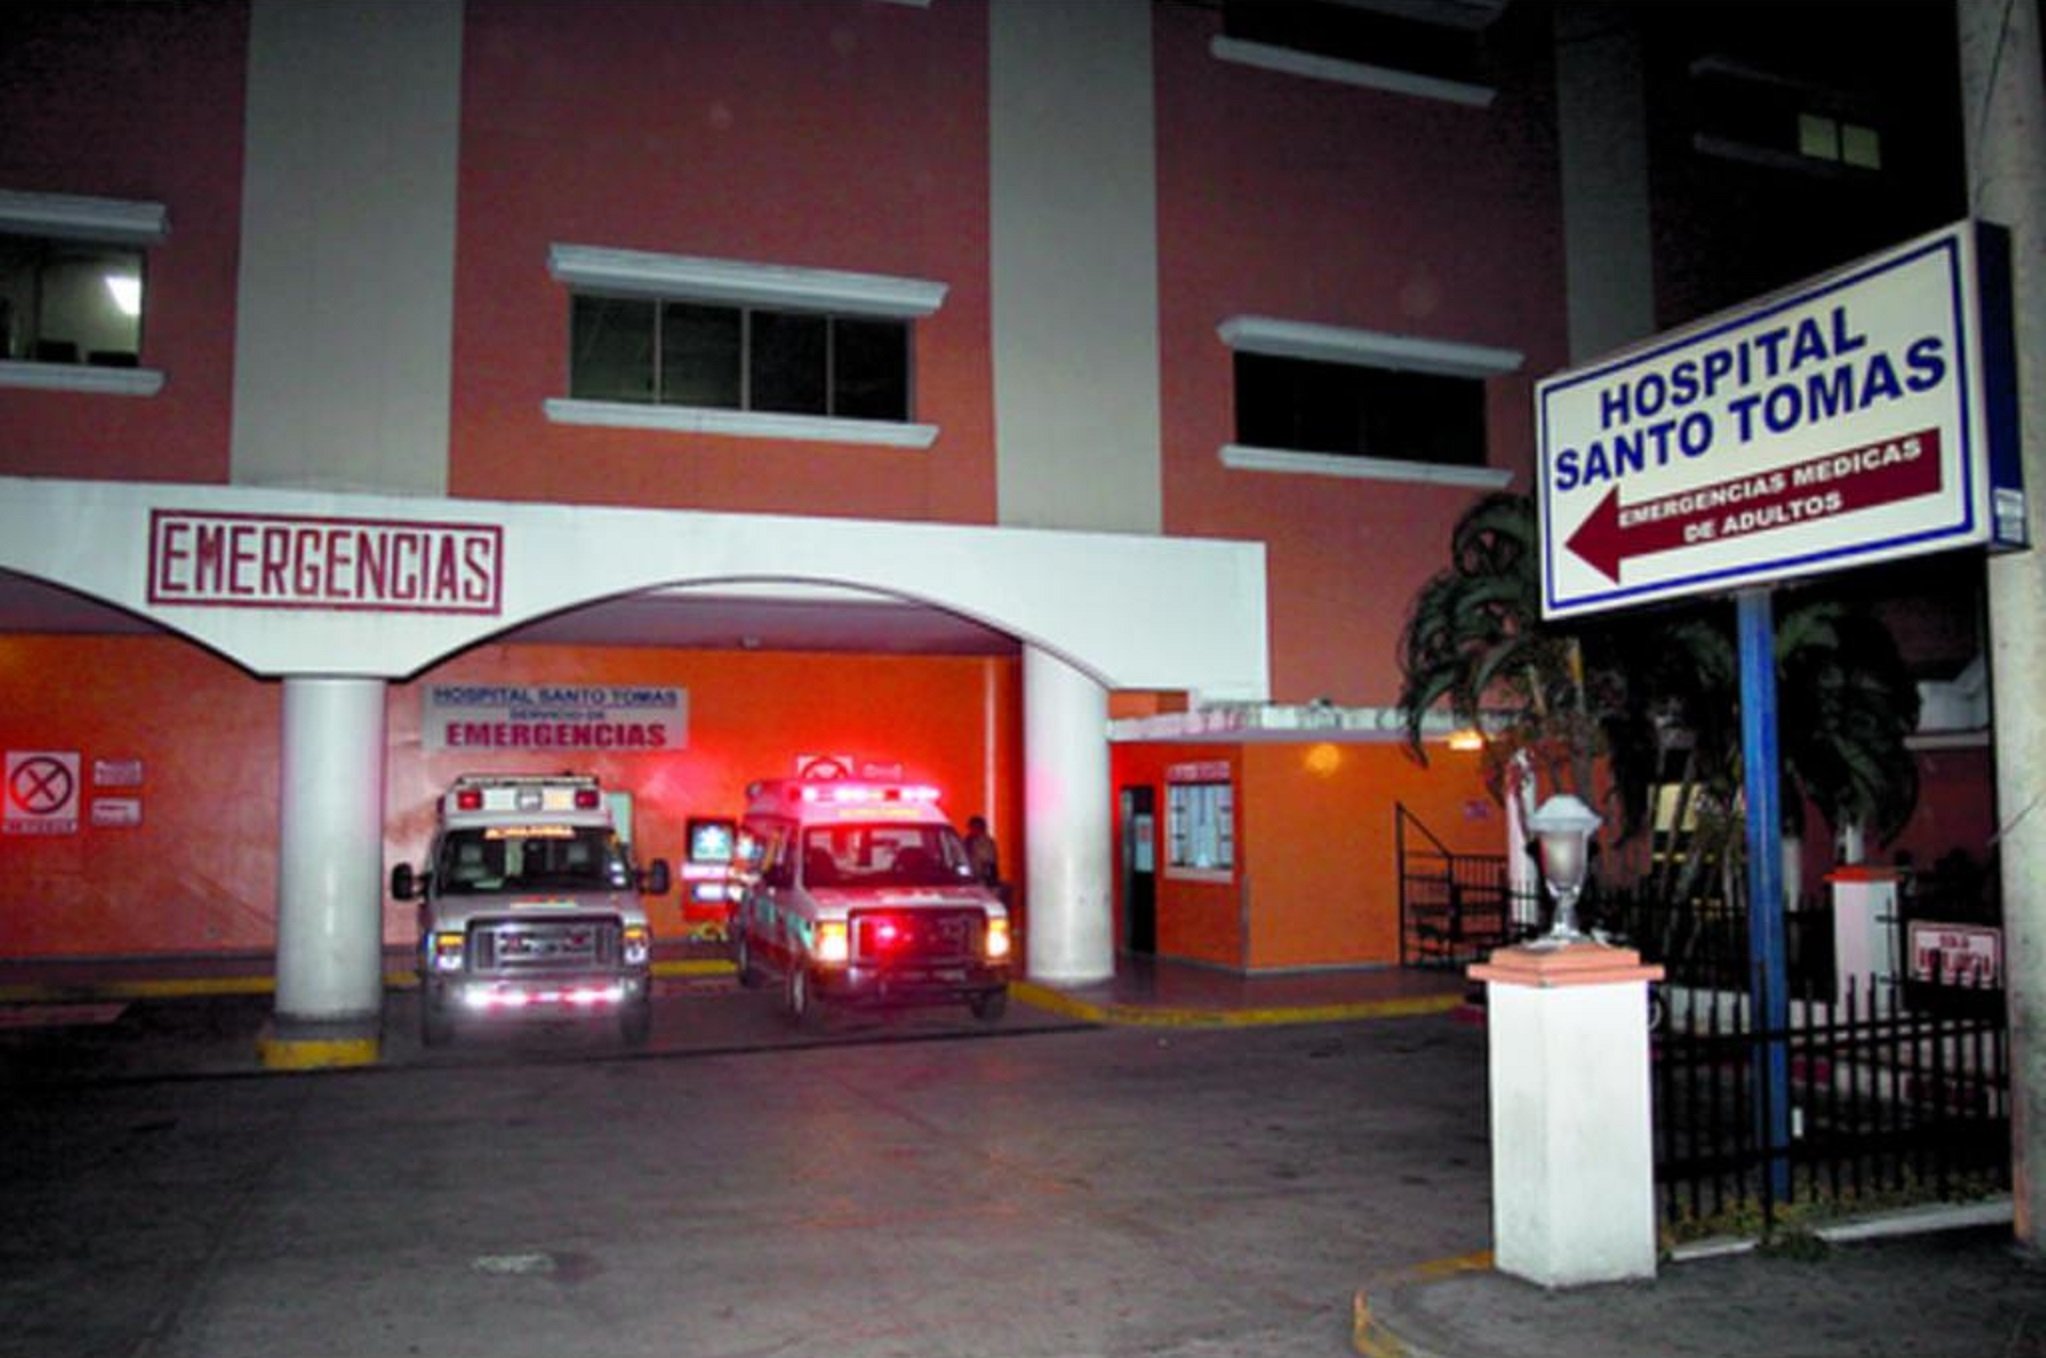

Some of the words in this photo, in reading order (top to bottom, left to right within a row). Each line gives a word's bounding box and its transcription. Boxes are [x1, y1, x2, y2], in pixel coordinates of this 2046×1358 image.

[1600, 306, 1867, 430] HOSPITAL
[1555, 412, 1713, 493] SANTO
[1728, 336, 1946, 443] TOMAS
[1618, 470, 1787, 529] EMERGENCIAS
[1791, 438, 1922, 487] MEDICAS
[1683, 518, 1715, 543] DE
[1720, 491, 1843, 536] ADULTOS
[160, 521, 491, 603] EMERGENCIAS
[433, 686, 534, 704] HOSPITAL
[539, 687, 606, 704] SANTO
[611, 689, 677, 706] TOMAS
[446, 722, 667, 747] EMERGENCIAS
